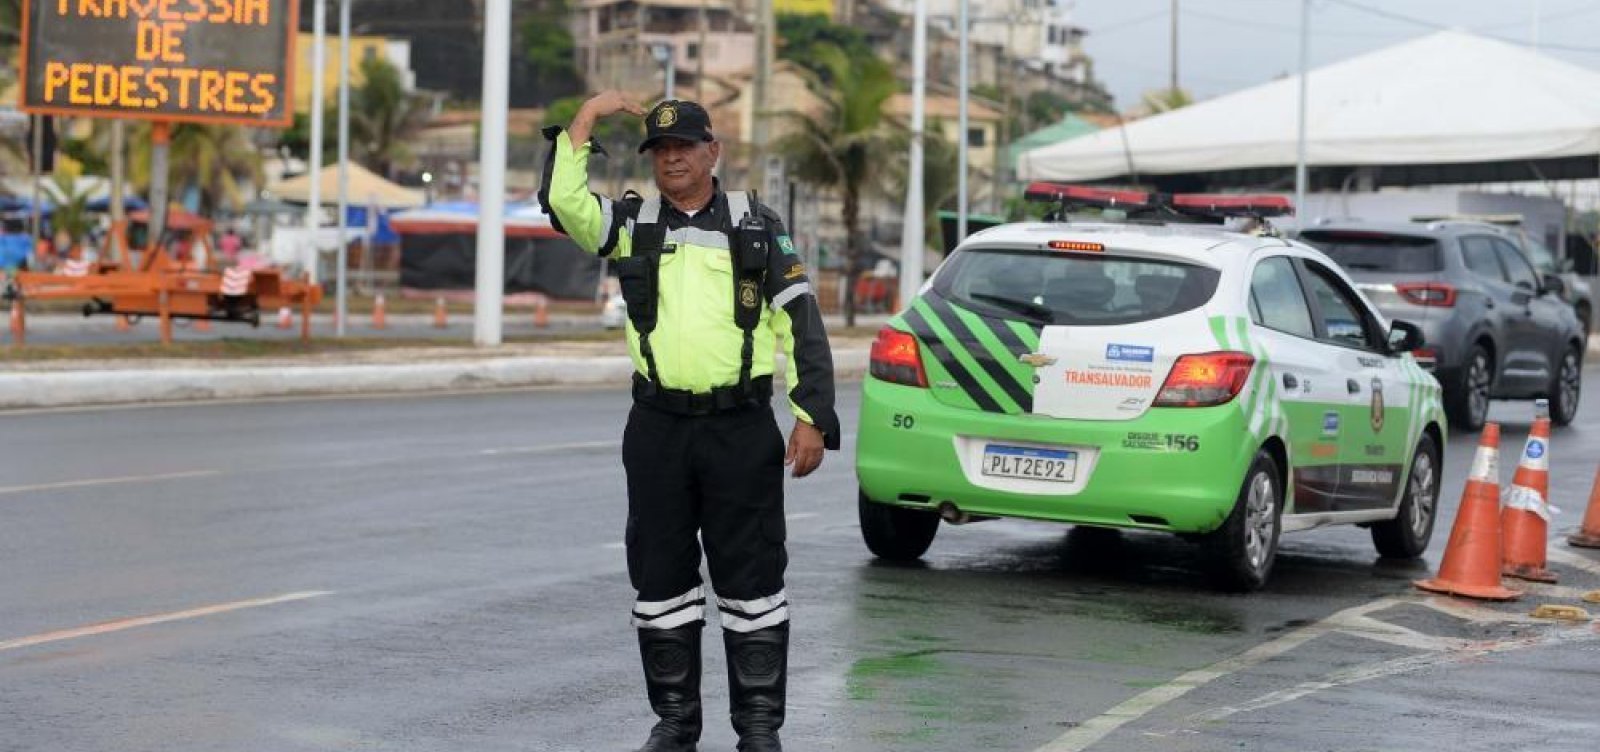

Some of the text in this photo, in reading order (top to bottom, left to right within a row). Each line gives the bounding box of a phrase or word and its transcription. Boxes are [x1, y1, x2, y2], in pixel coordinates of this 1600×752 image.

[136, 20, 186, 62] DE
[44, 61, 275, 113] PEDESTRES
[1065, 369, 1152, 388] TRANSALVADOR
[893, 414, 915, 430] 50
[1164, 432, 1200, 452] 156
[990, 455, 1066, 479] PLT2E92
